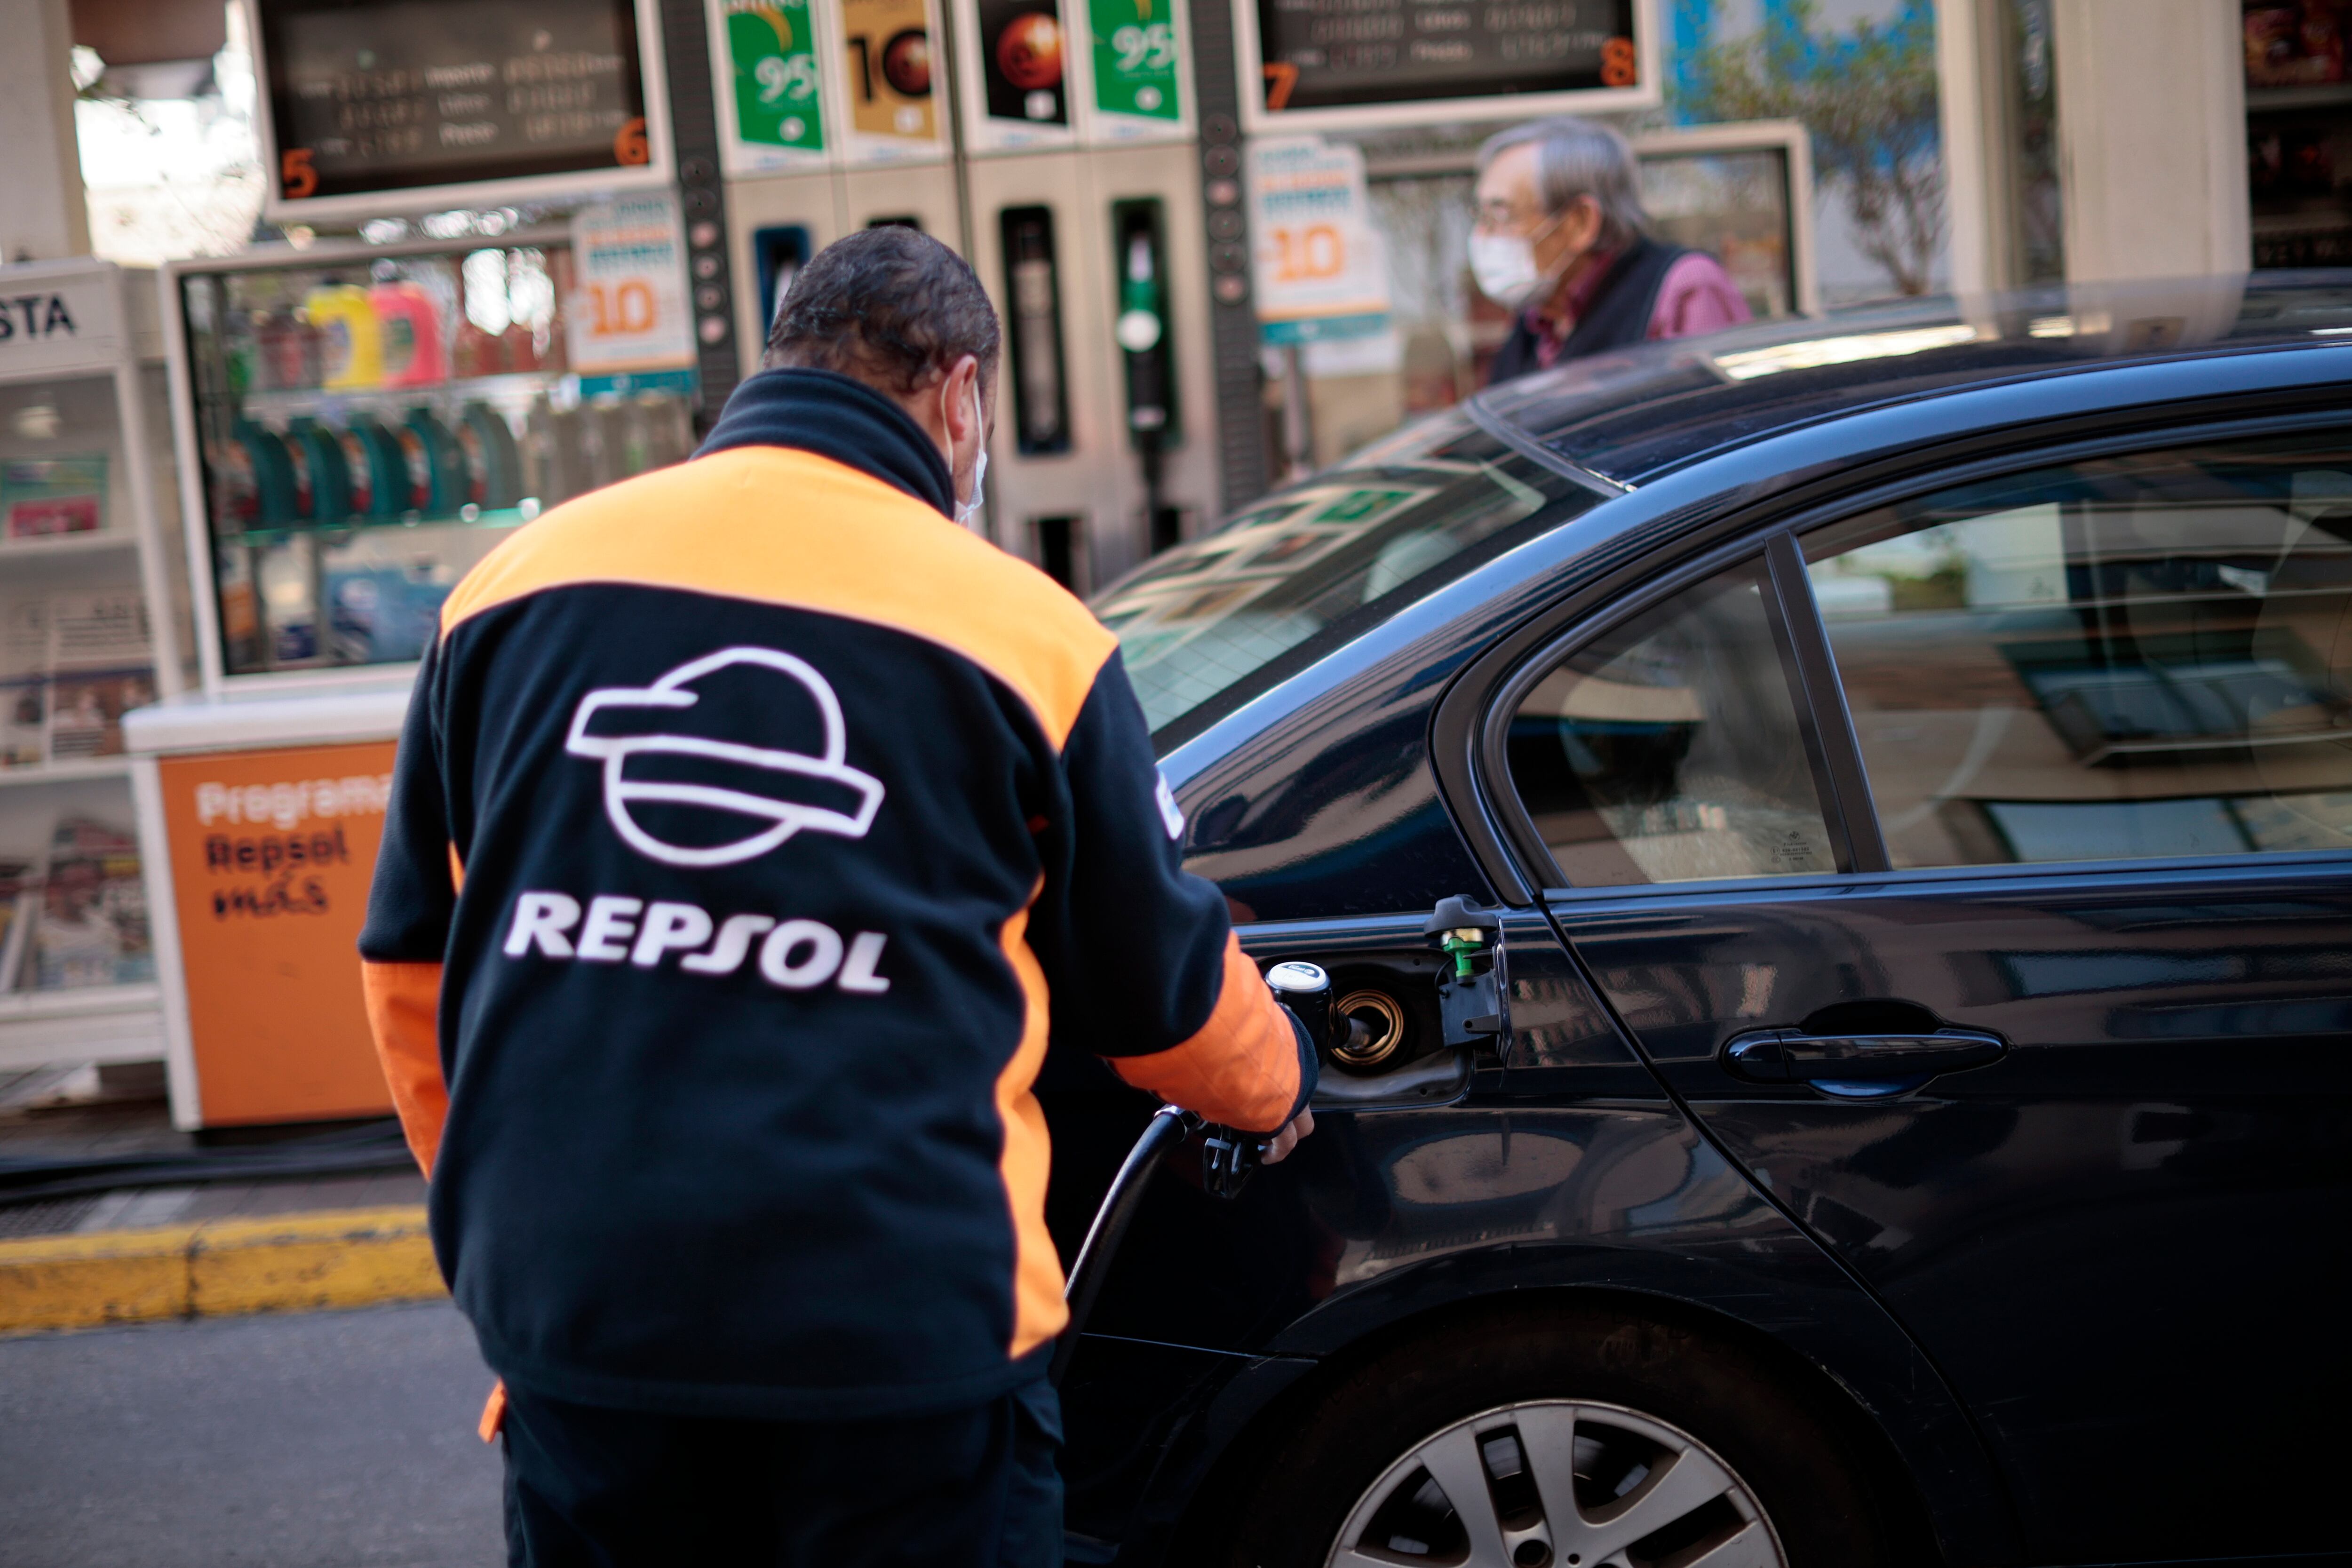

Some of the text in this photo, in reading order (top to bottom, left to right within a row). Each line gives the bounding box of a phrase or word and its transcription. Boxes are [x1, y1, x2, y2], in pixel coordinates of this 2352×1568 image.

[1111, 23, 1175, 72] 95
[1600, 36, 1637, 87] 8
[755, 52, 816, 104] 95
[1263, 62, 1299, 111] 7
[614, 116, 649, 166] 6
[281, 147, 319, 199] 5
[1271, 223, 1344, 283] 10
[587, 277, 658, 337] 10
[206, 824, 349, 878] Repsol
[503, 892, 891, 994] REPSOL
